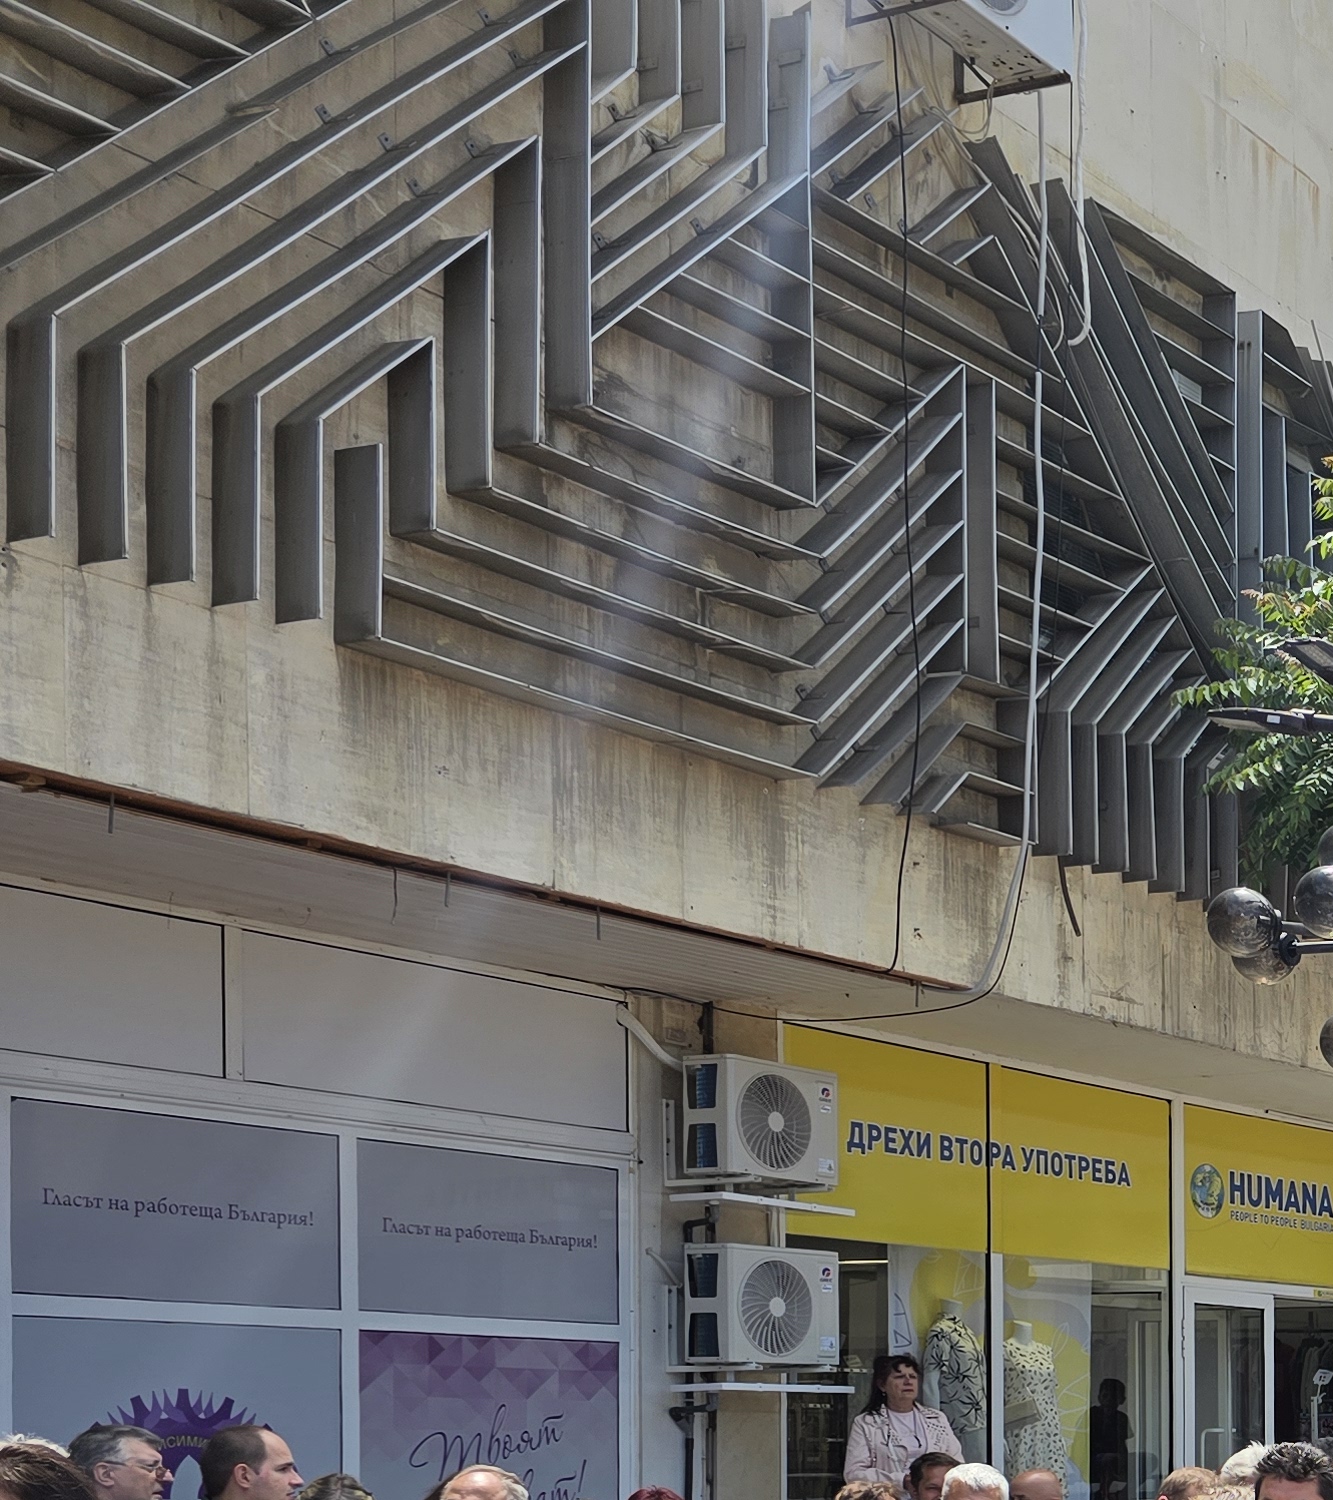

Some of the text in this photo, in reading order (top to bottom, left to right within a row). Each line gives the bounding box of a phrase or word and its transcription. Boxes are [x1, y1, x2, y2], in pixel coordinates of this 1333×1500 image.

[847, 1121, 1131, 1187] ДРЕХИ ВТОРА УПОТРЕБА
[42, 1188, 314, 1229] Гласът на работеща България!
[1229, 1171, 1333, 1218] HUMANA
[382, 1217, 598, 1251] Гласът на работеща България!
[1230, 1211, 1258, 1224] PEOPLE
[1260, 1213, 1270, 1225] TO
[1271, 1216, 1298, 1229] PEOPLE
[409, 1404, 564, 1481] Твоят
